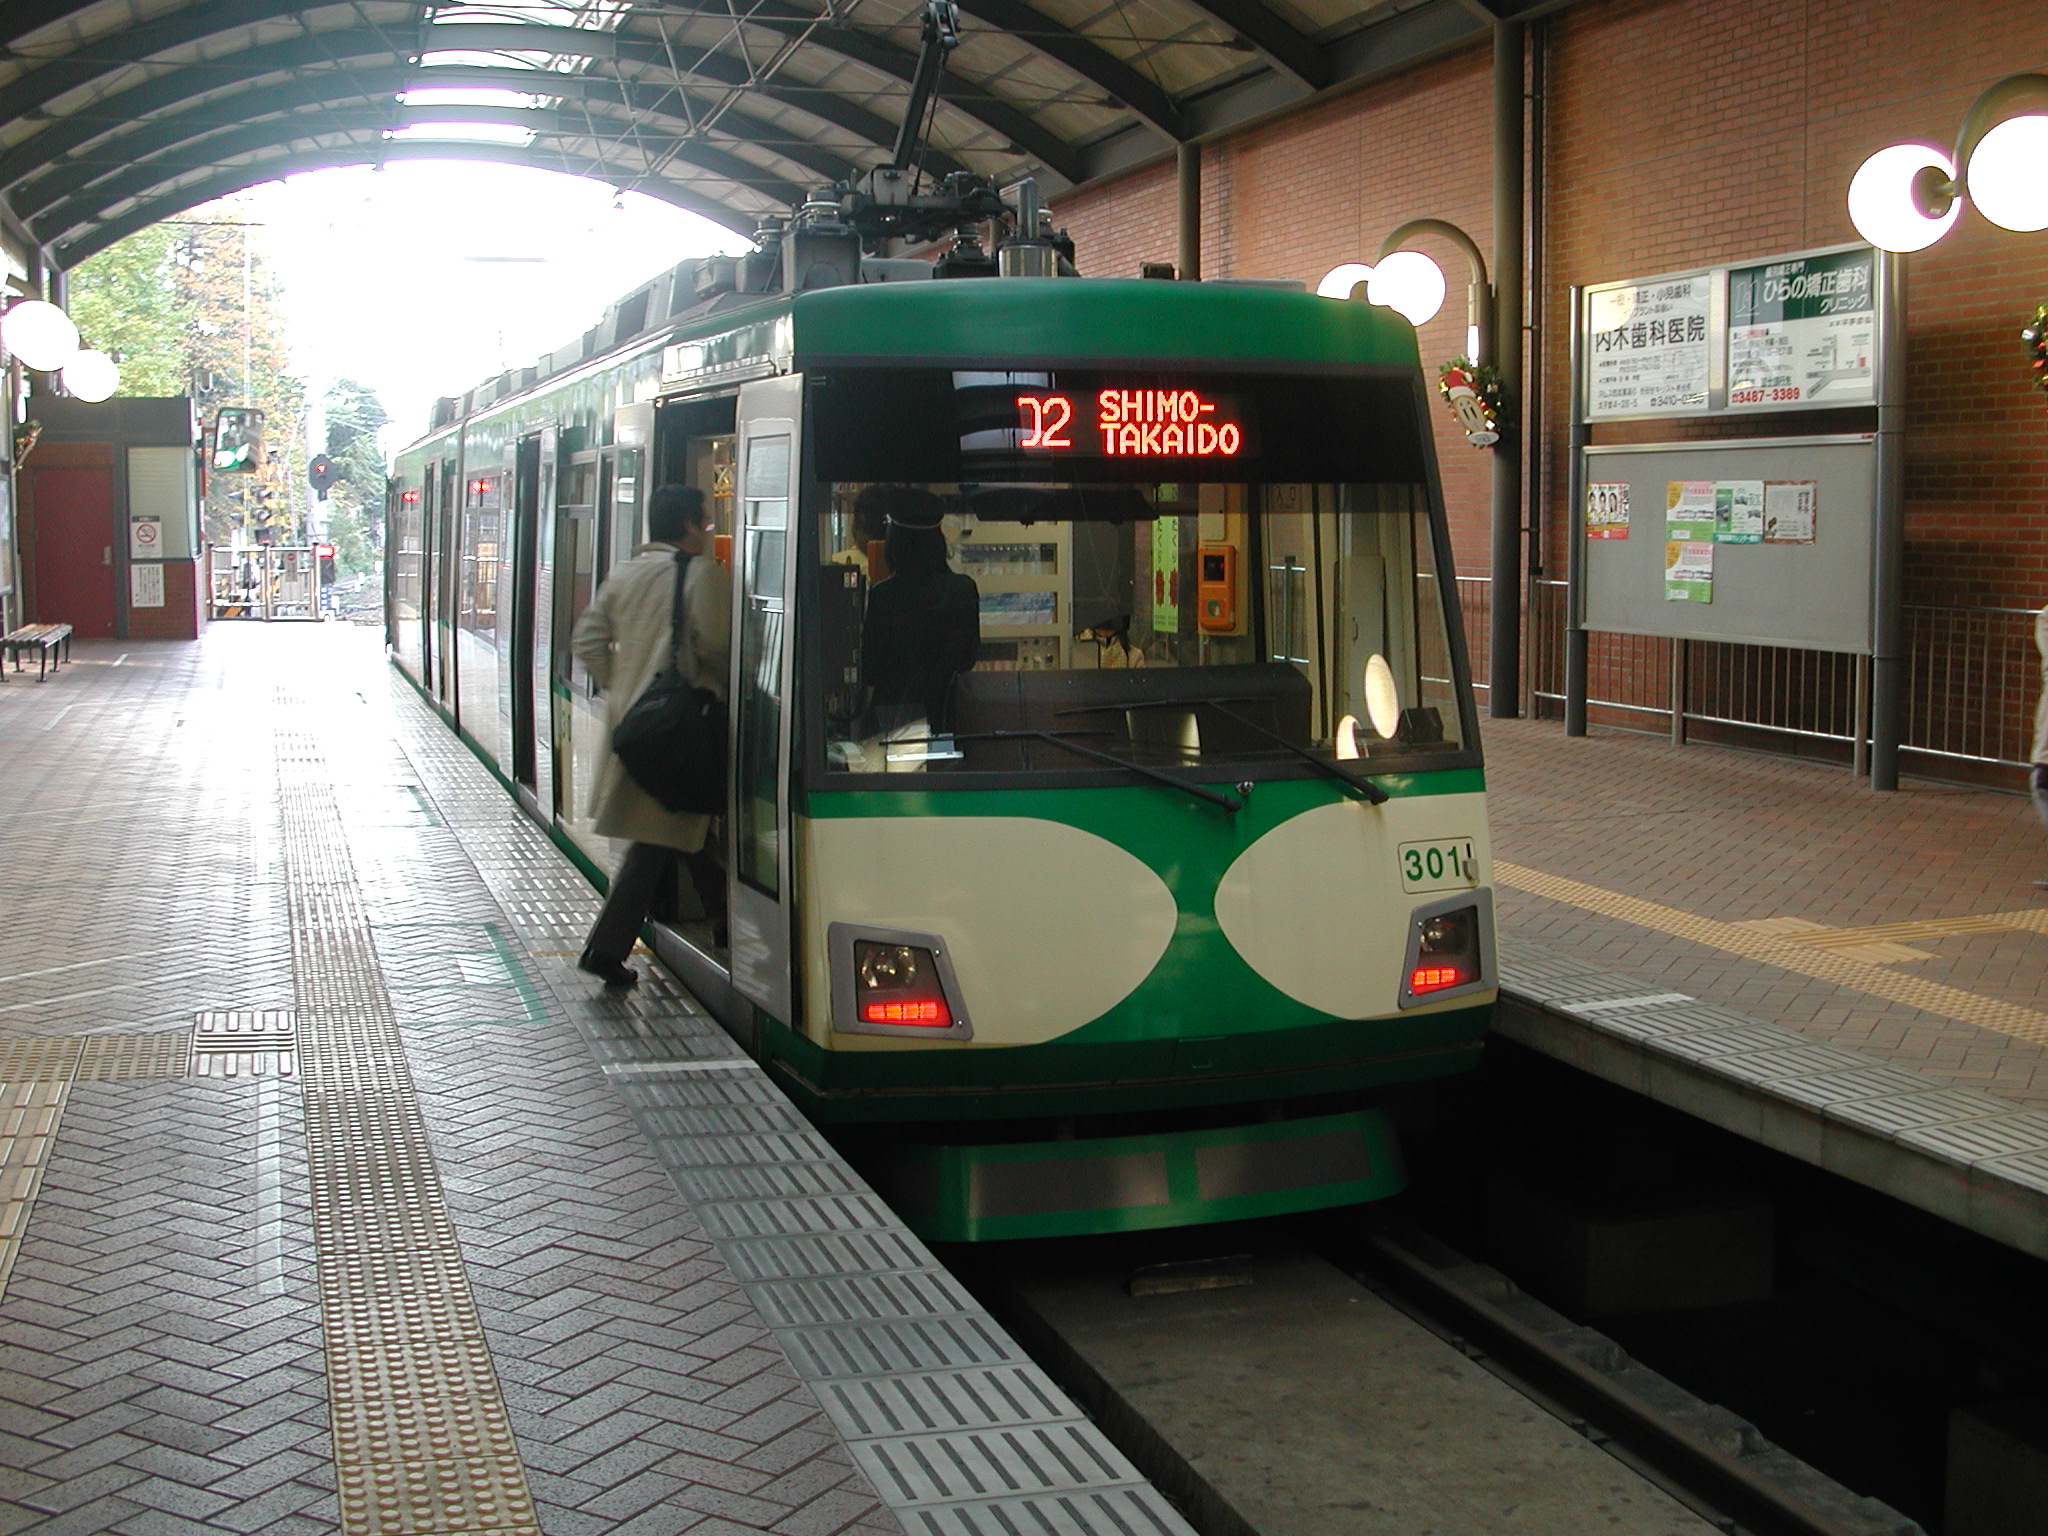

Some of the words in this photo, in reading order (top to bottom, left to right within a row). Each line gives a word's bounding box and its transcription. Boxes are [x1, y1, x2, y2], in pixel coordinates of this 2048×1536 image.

[1763, 264, 1870, 304] ひらの矯正歯科
[1820, 293, 1869, 314] クリニック
[1099, 389, 1215, 422] SHIMO-
[1739, 387, 1801, 404] 3487-3389
[1100, 423, 1240, 455] TAKAIDO
